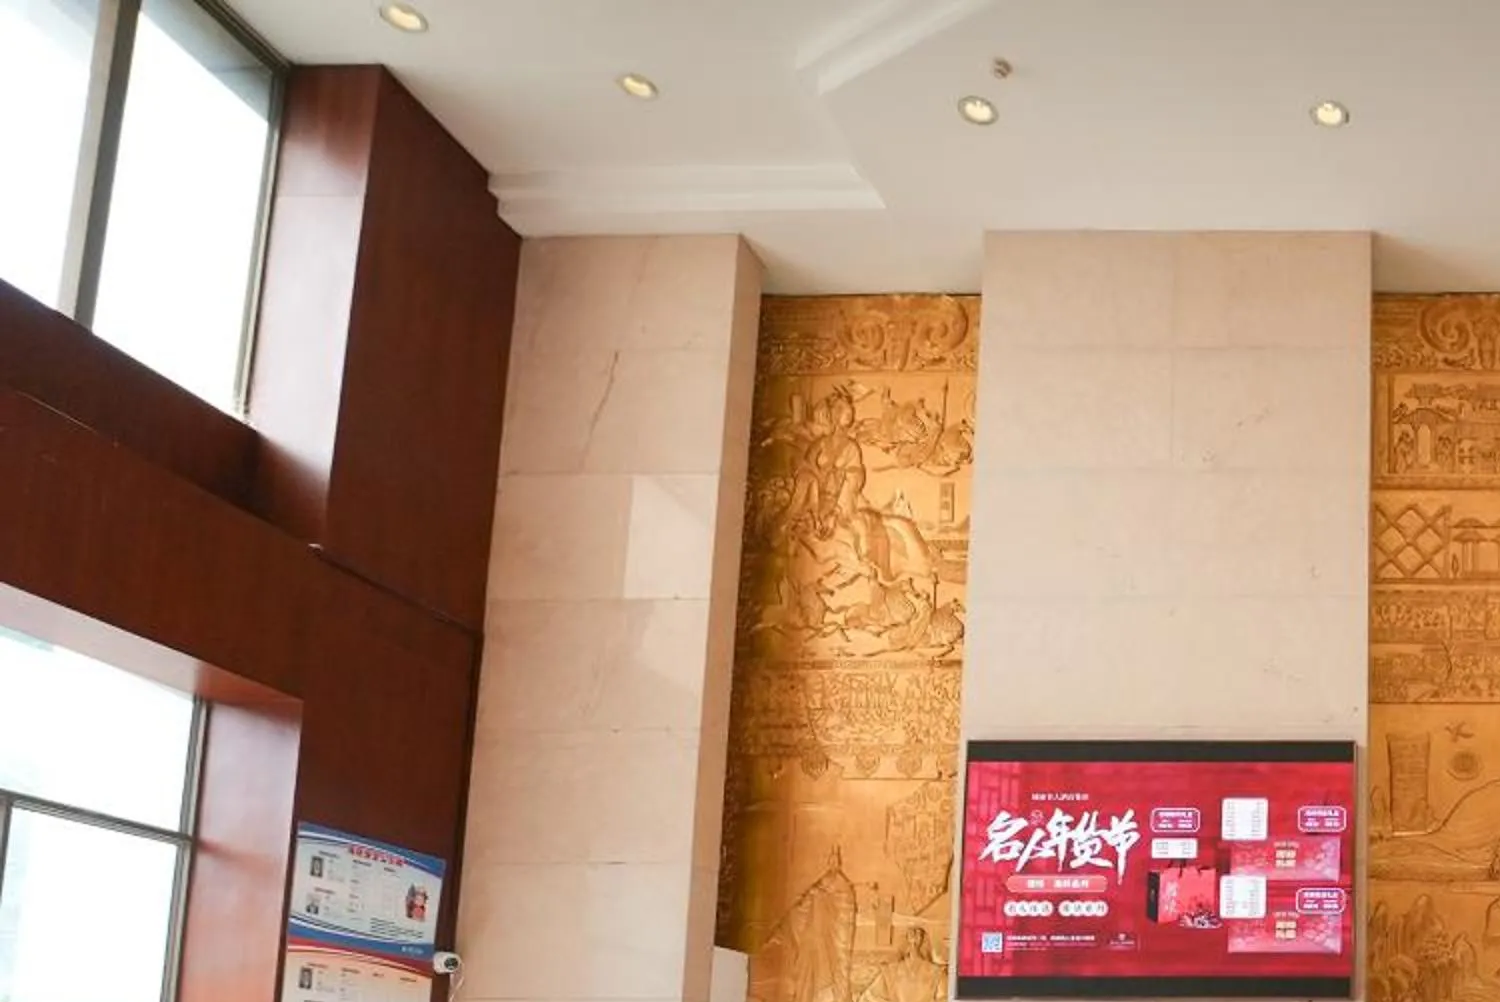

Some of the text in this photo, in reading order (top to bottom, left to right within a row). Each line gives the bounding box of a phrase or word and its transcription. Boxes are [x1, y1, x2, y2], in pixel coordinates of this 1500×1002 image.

[979, 808, 1141, 885] 名人年货节
